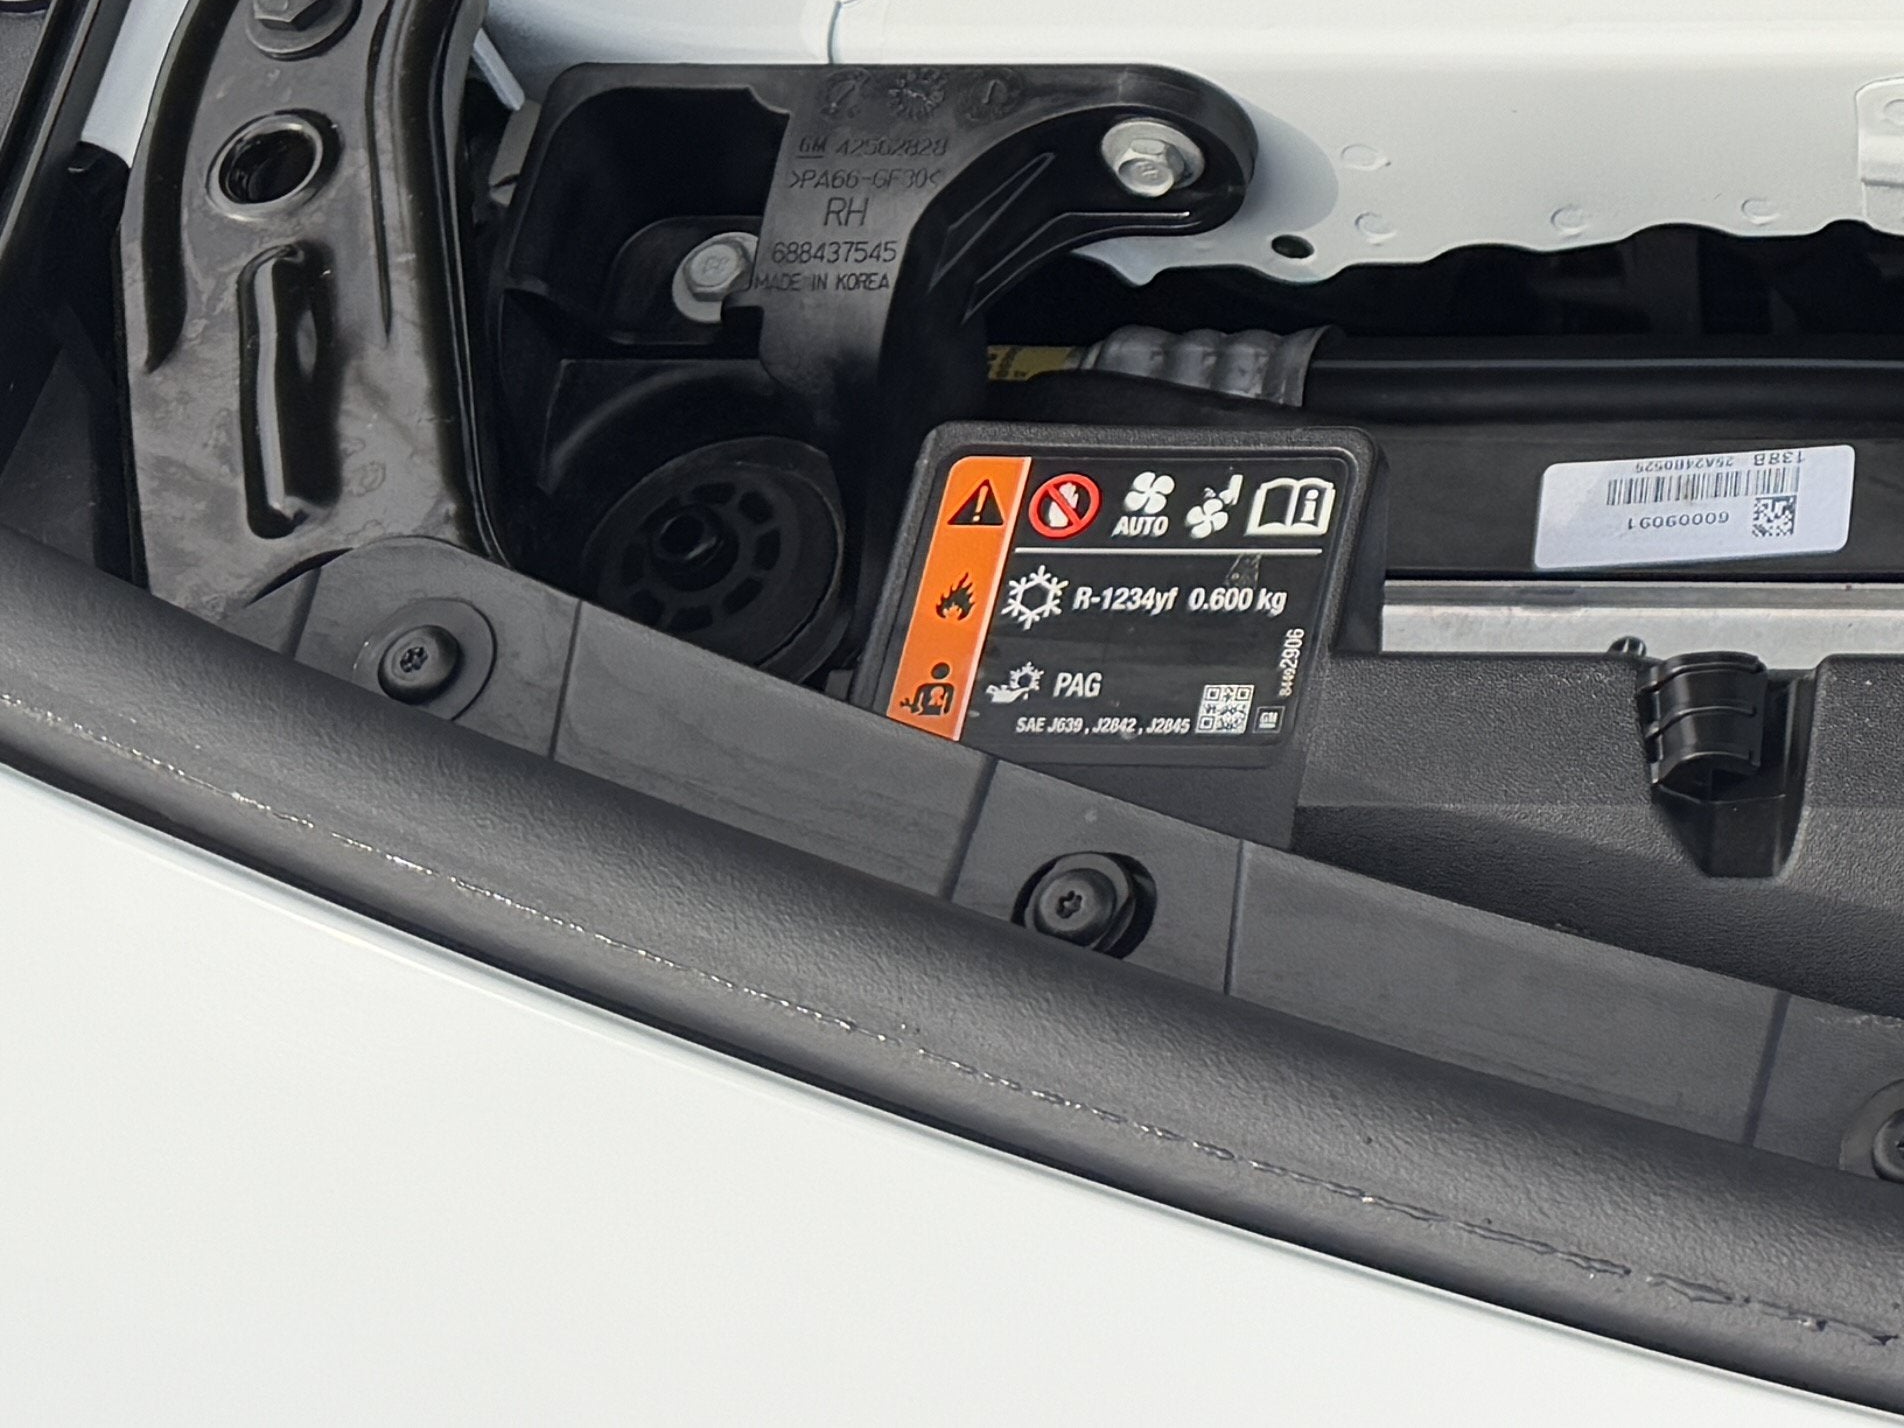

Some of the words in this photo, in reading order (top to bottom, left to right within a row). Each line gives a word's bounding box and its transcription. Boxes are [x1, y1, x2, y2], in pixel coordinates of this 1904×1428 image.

[823, 196, 870, 227] RH
[771, 240, 899, 265] 688437545
[754, 272, 801, 291] MADE
[811, 272, 829, 291] IN
[835, 272, 891, 291] KOREA
[1111, 515, 1170, 538] AUTO
[1628, 511, 1731, 531] 60009091
[1072, 586, 1180, 616] R-1234yf
[1187, 587, 1255, 612] 0.600
[1255, 588, 1288, 617] kg
[1052, 672, 1103, 699] PAG
[1015, 716, 1046, 734] SAE
